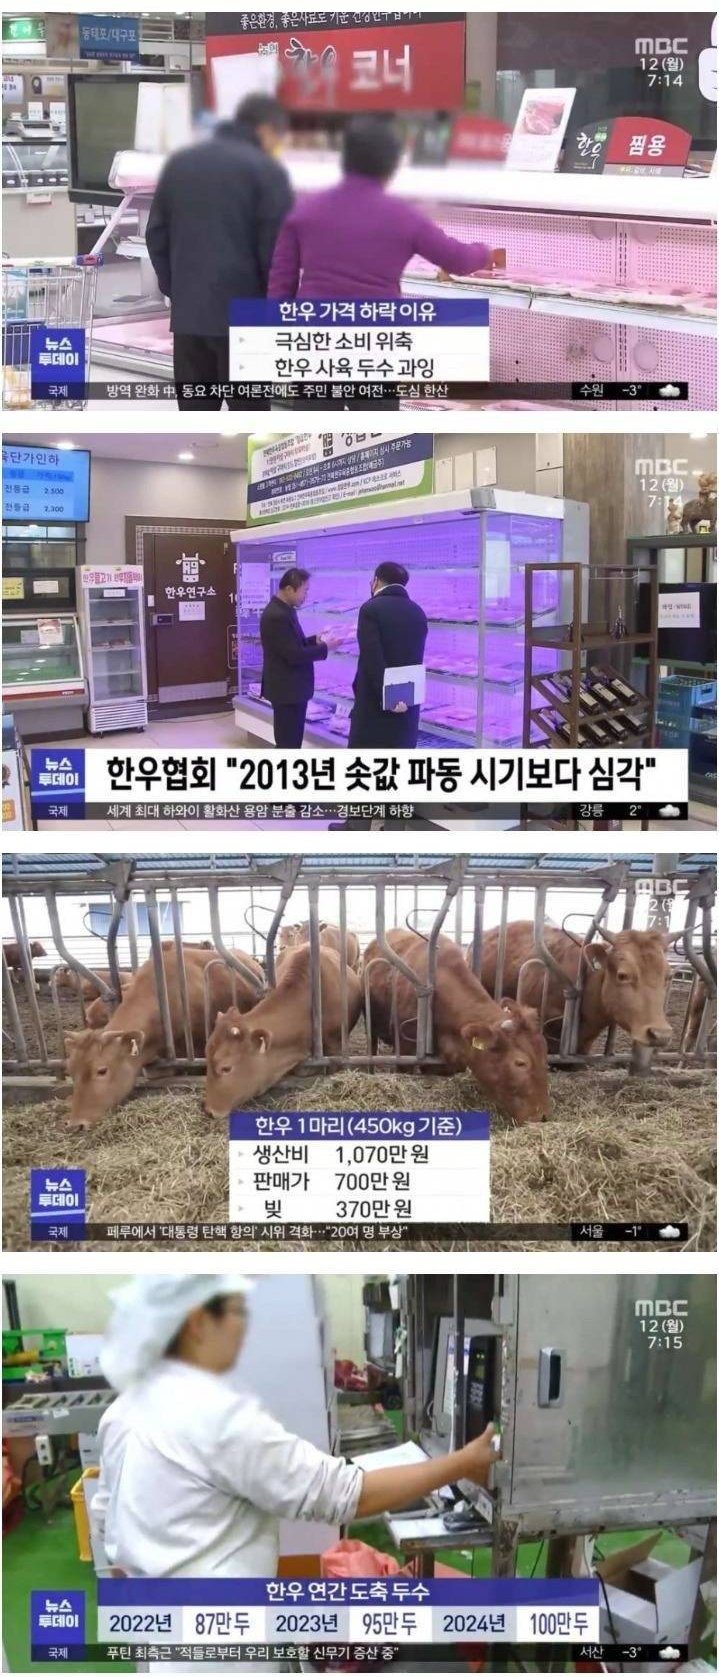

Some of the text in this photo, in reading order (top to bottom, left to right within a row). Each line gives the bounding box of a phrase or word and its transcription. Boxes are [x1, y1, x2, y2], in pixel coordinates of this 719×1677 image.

[350, 44, 412, 93] 코너
[629, 134, 667, 157] 찜용
[165, 587, 216, 599] 한우연구소
